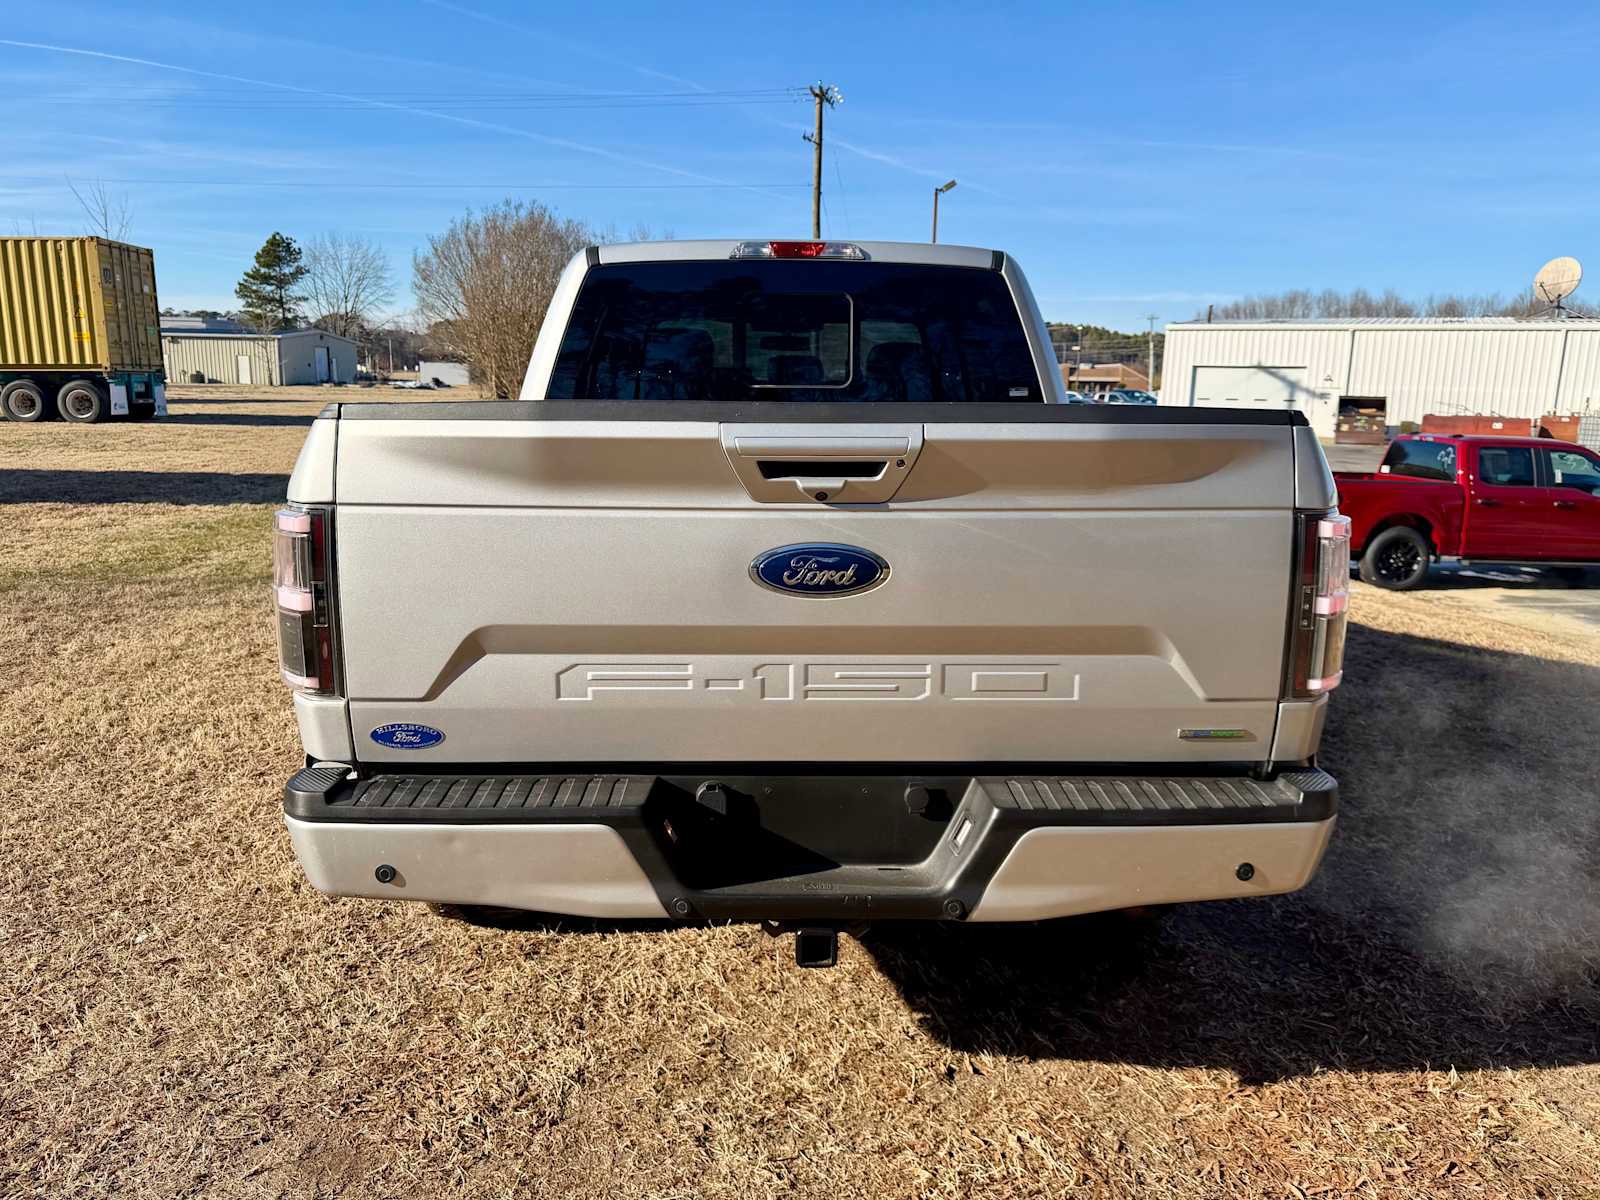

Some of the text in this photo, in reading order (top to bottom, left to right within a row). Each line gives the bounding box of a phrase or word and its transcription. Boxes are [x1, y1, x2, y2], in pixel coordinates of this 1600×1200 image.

[783, 555, 857, 586] Ford
[556, 663, 1081, 701] F-150
[376, 724, 438, 735] HILLSBORO
[393, 730, 421, 743] Ford
